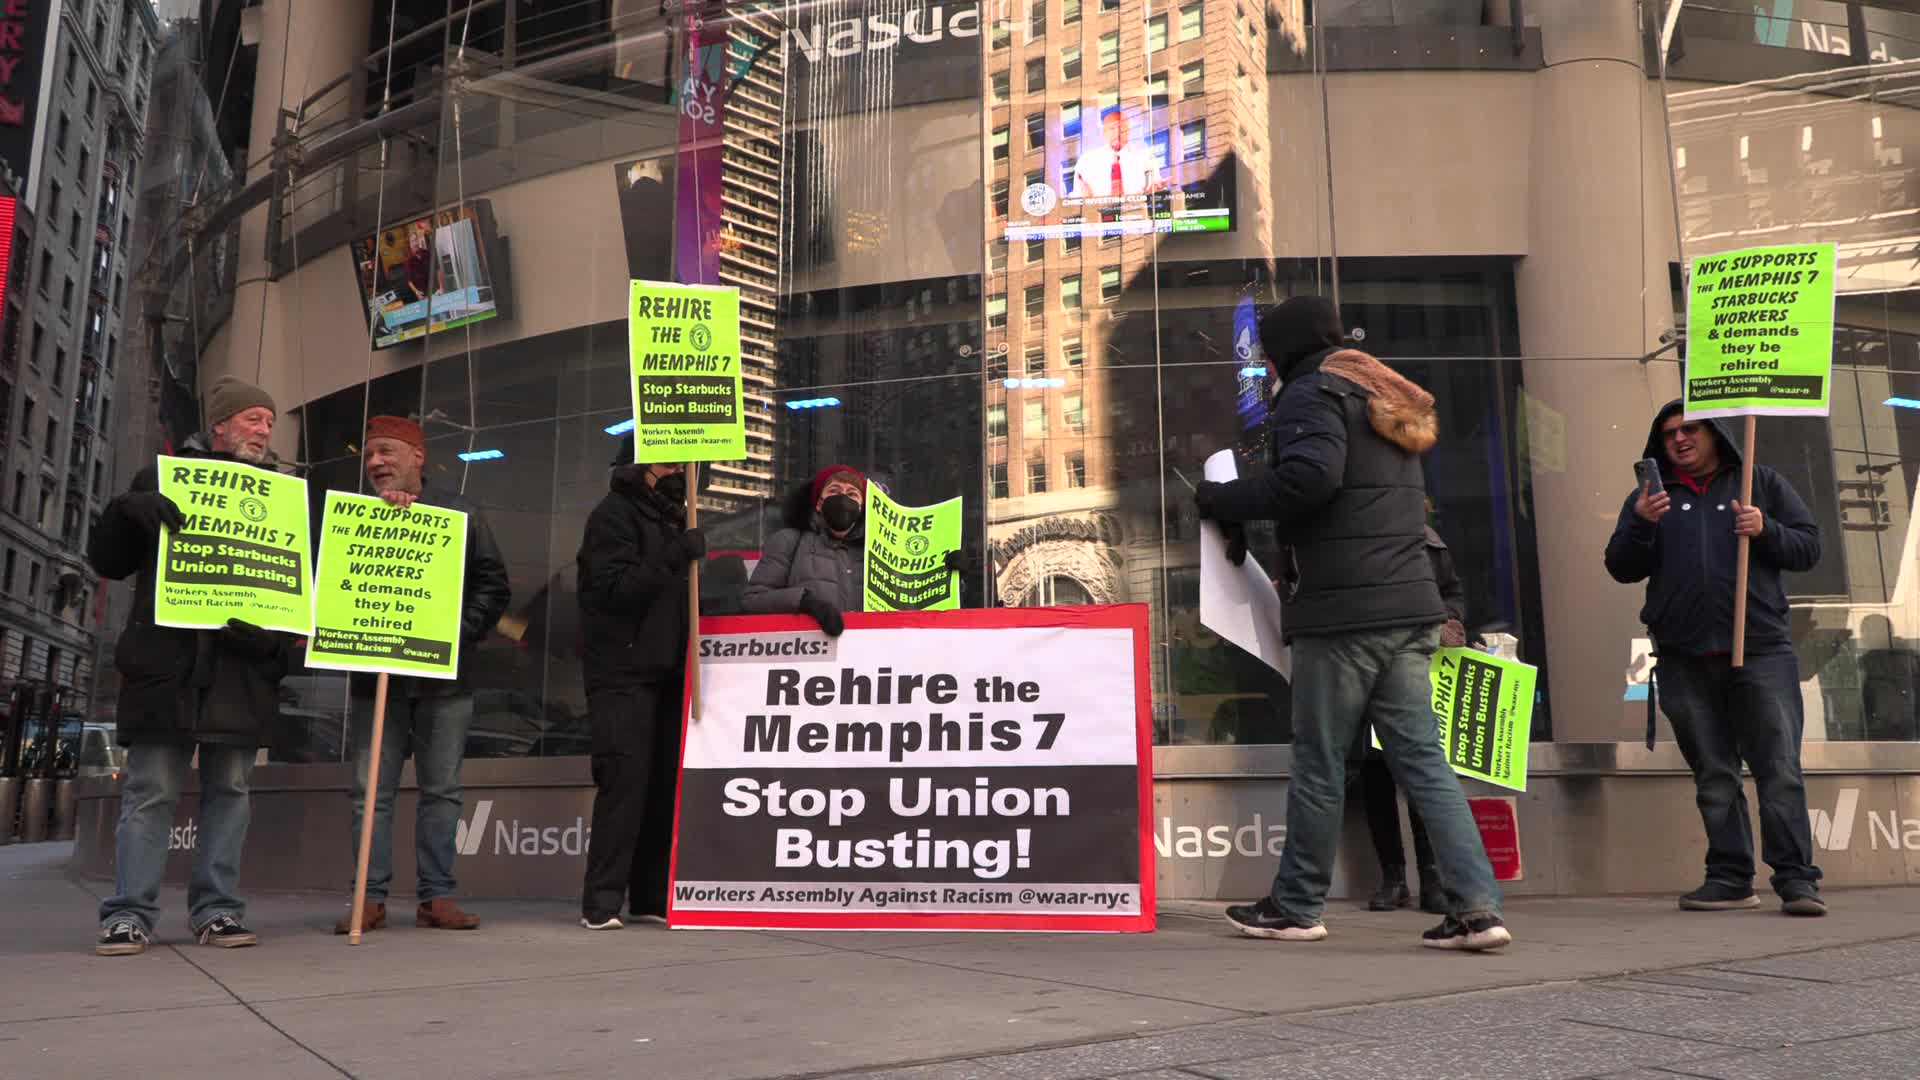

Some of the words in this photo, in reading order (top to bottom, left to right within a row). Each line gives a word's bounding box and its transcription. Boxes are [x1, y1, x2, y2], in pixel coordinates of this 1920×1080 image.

[1697, 259, 1728, 276] NYC
[1731, 252, 1819, 271] SUPPORTS
[1696, 284, 1714, 294] THE
[1718, 270, 1803, 291] MEMPHIS
[1807, 270, 1819, 284] 7
[639, 296, 712, 321] REHIRE
[1711, 291, 1799, 310] STARBUCKS
[1714, 309, 1790, 326] WORKERS
[651, 327, 682, 343] THE
[1707, 328, 1720, 340] &
[1723, 325, 1800, 339] demands
[1721, 343, 1756, 355] they
[1759, 341, 1781, 353] be
[642, 354, 719, 371] MEMPHIS
[722, 356, 731, 372] 7
[1720, 358, 1780, 372] rehired
[643, 383, 672, 397] Stop
[676, 383, 732, 395] Starbucks
[1691, 378, 1727, 388] Workers
[1729, 375, 1773, 386] Assembly
[1691, 388, 1722, 398] Against
[1724, 386, 1758, 395] Racism
[644, 402, 685, 413] Union
[688, 402, 732, 416] Busting
[642, 428, 672, 436] Workers
[642, 437, 669, 446] Against
[670, 437, 698, 445] Racism
[173, 467, 272, 497] REHIRE
[190, 491, 228, 509] THE
[333, 501, 366, 518] NYC
[369, 507, 451, 529] SUPPORTS
[872, 495, 934, 534] REHIRE
[180, 512, 278, 543] MEMPHIS
[284, 532, 296, 547] 7
[331, 525, 350, 535] THE
[355, 524, 437, 546] MEMPHIS
[441, 535, 452, 548] 7
[878, 521, 897, 546] THE
[172, 541, 213, 557] Stop
[218, 545, 296, 568] Starbucks
[347, 543, 433, 564] STARBUCKS
[872, 538, 937, 571] MEMPHIS
[171, 560, 228, 574] Union
[233, 564, 297, 588] Busting
[349, 562, 425, 580] WORKERS
[870, 559, 889, 580] Stop
[890, 571, 948, 589] Starbucks
[165, 586, 208, 596] Workers
[340, 579, 352, 592] &
[357, 582, 432, 600] demands
[870, 573, 897, 601] Union
[899, 584, 947, 604] Busting
[165, 597, 202, 607] Against
[206, 599, 244, 607] Racism
[354, 597, 391, 612] they
[395, 601, 415, 614] be
[352, 617, 413, 631] rehired
[316, 639, 353, 650] Against
[355, 642, 392, 653] Racism
[318, 628, 359, 640] Workers
[361, 633, 407, 646] Assembly
[699, 637, 829, 657] Starbucks:
[1441, 655, 1455, 669] 7
[765, 667, 958, 706] Rehire
[974, 676, 1040, 702] the
[1458, 663, 1476, 730] Starbucks
[1476, 668, 1496, 723] Busting
[743, 712, 1021, 762] Memphis
[1033, 713, 1065, 749] 7
[1506, 720, 1514, 749] Racism
[1456, 735, 1469, 764] Stop
[1472, 726, 1487, 768] Union
[1493, 745, 1503, 778] Workers
[1503, 751, 1511, 779] Against
[722, 778, 866, 826] Stop
[889, 777, 1070, 817] Union
[1154, 813, 1288, 858] Nasda
[775, 829, 1031, 879] Busting!
[675, 886, 755, 901] Workers
[760, 887, 855, 906] Assembly
[859, 888, 937, 907] Against
[942, 888, 1013, 904] Racism
[1018, 889, 1130, 909] @waar-nyc
